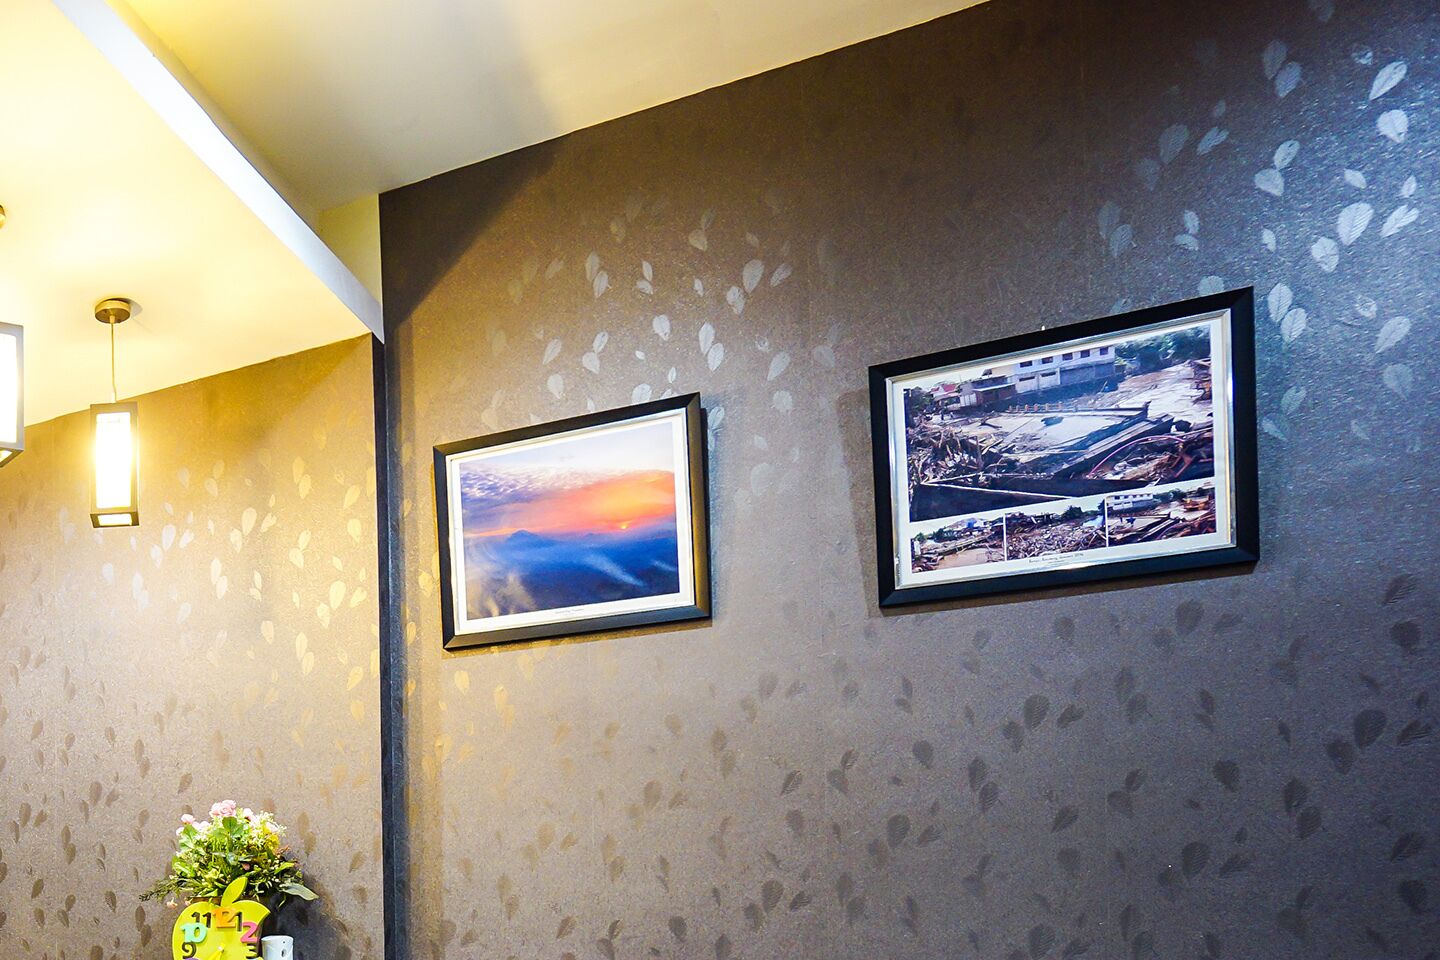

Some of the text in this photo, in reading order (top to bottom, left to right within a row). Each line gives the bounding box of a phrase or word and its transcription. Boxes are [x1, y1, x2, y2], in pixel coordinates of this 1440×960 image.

[180, 922, 208, 943] 10
[240, 921, 259, 943] 2
[181, 942, 197, 959] 9
[245, 943, 258, 959] 3
